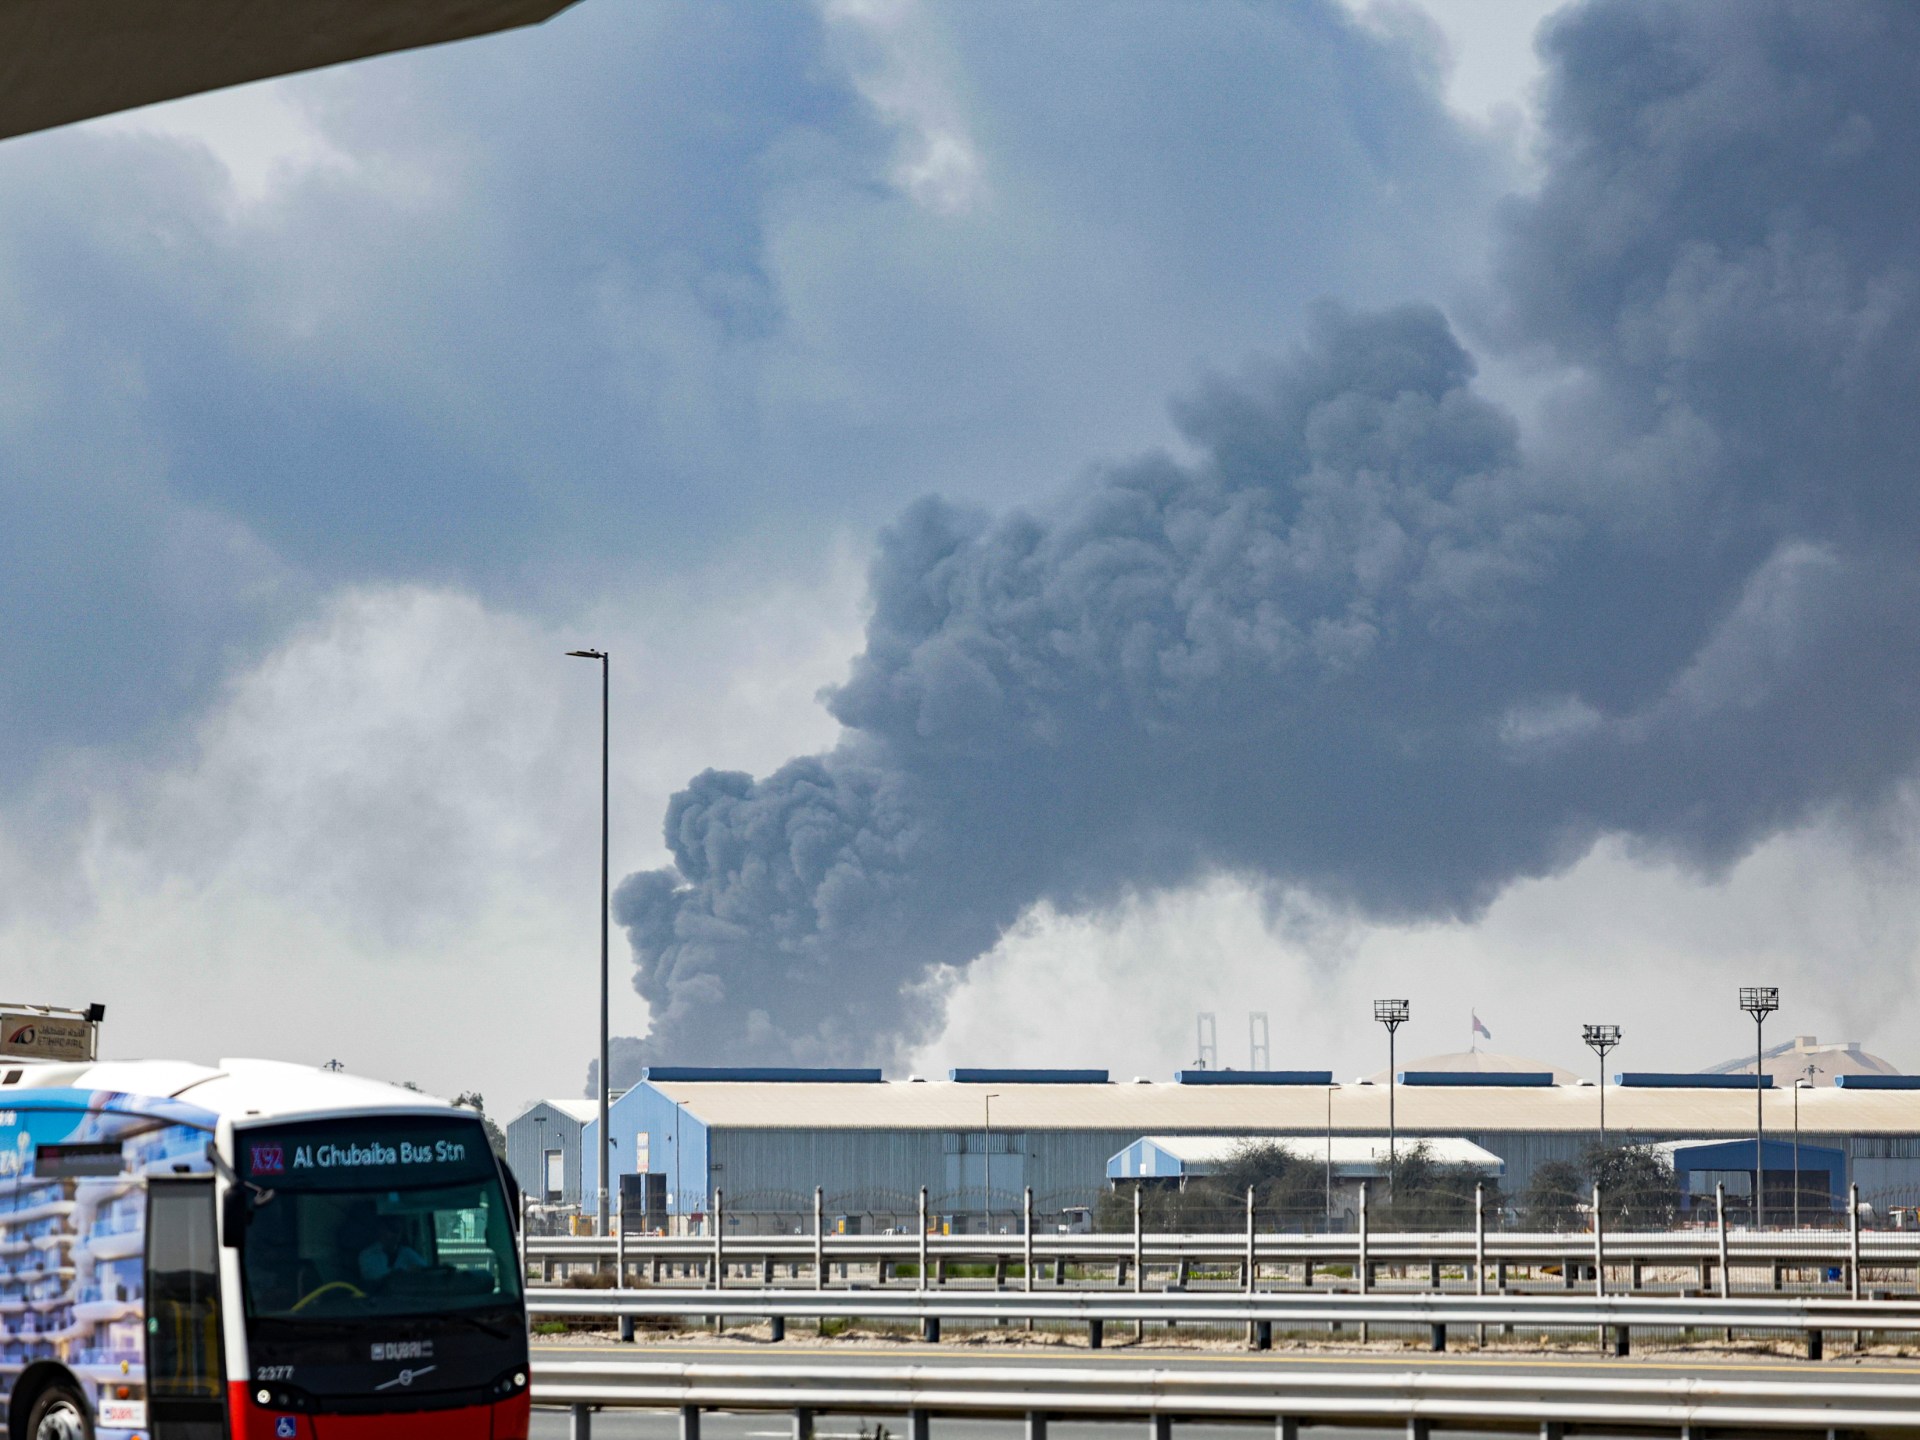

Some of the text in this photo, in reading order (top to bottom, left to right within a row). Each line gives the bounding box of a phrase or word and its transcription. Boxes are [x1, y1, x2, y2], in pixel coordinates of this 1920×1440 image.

[293, 1144, 314, 1168] Al
[317, 1142, 397, 1167] Ghubaiba
[400, 1141, 433, 1164] Bus
[435, 1140, 465, 1162] Stn
[257, 1365, 294, 1381] 2377
